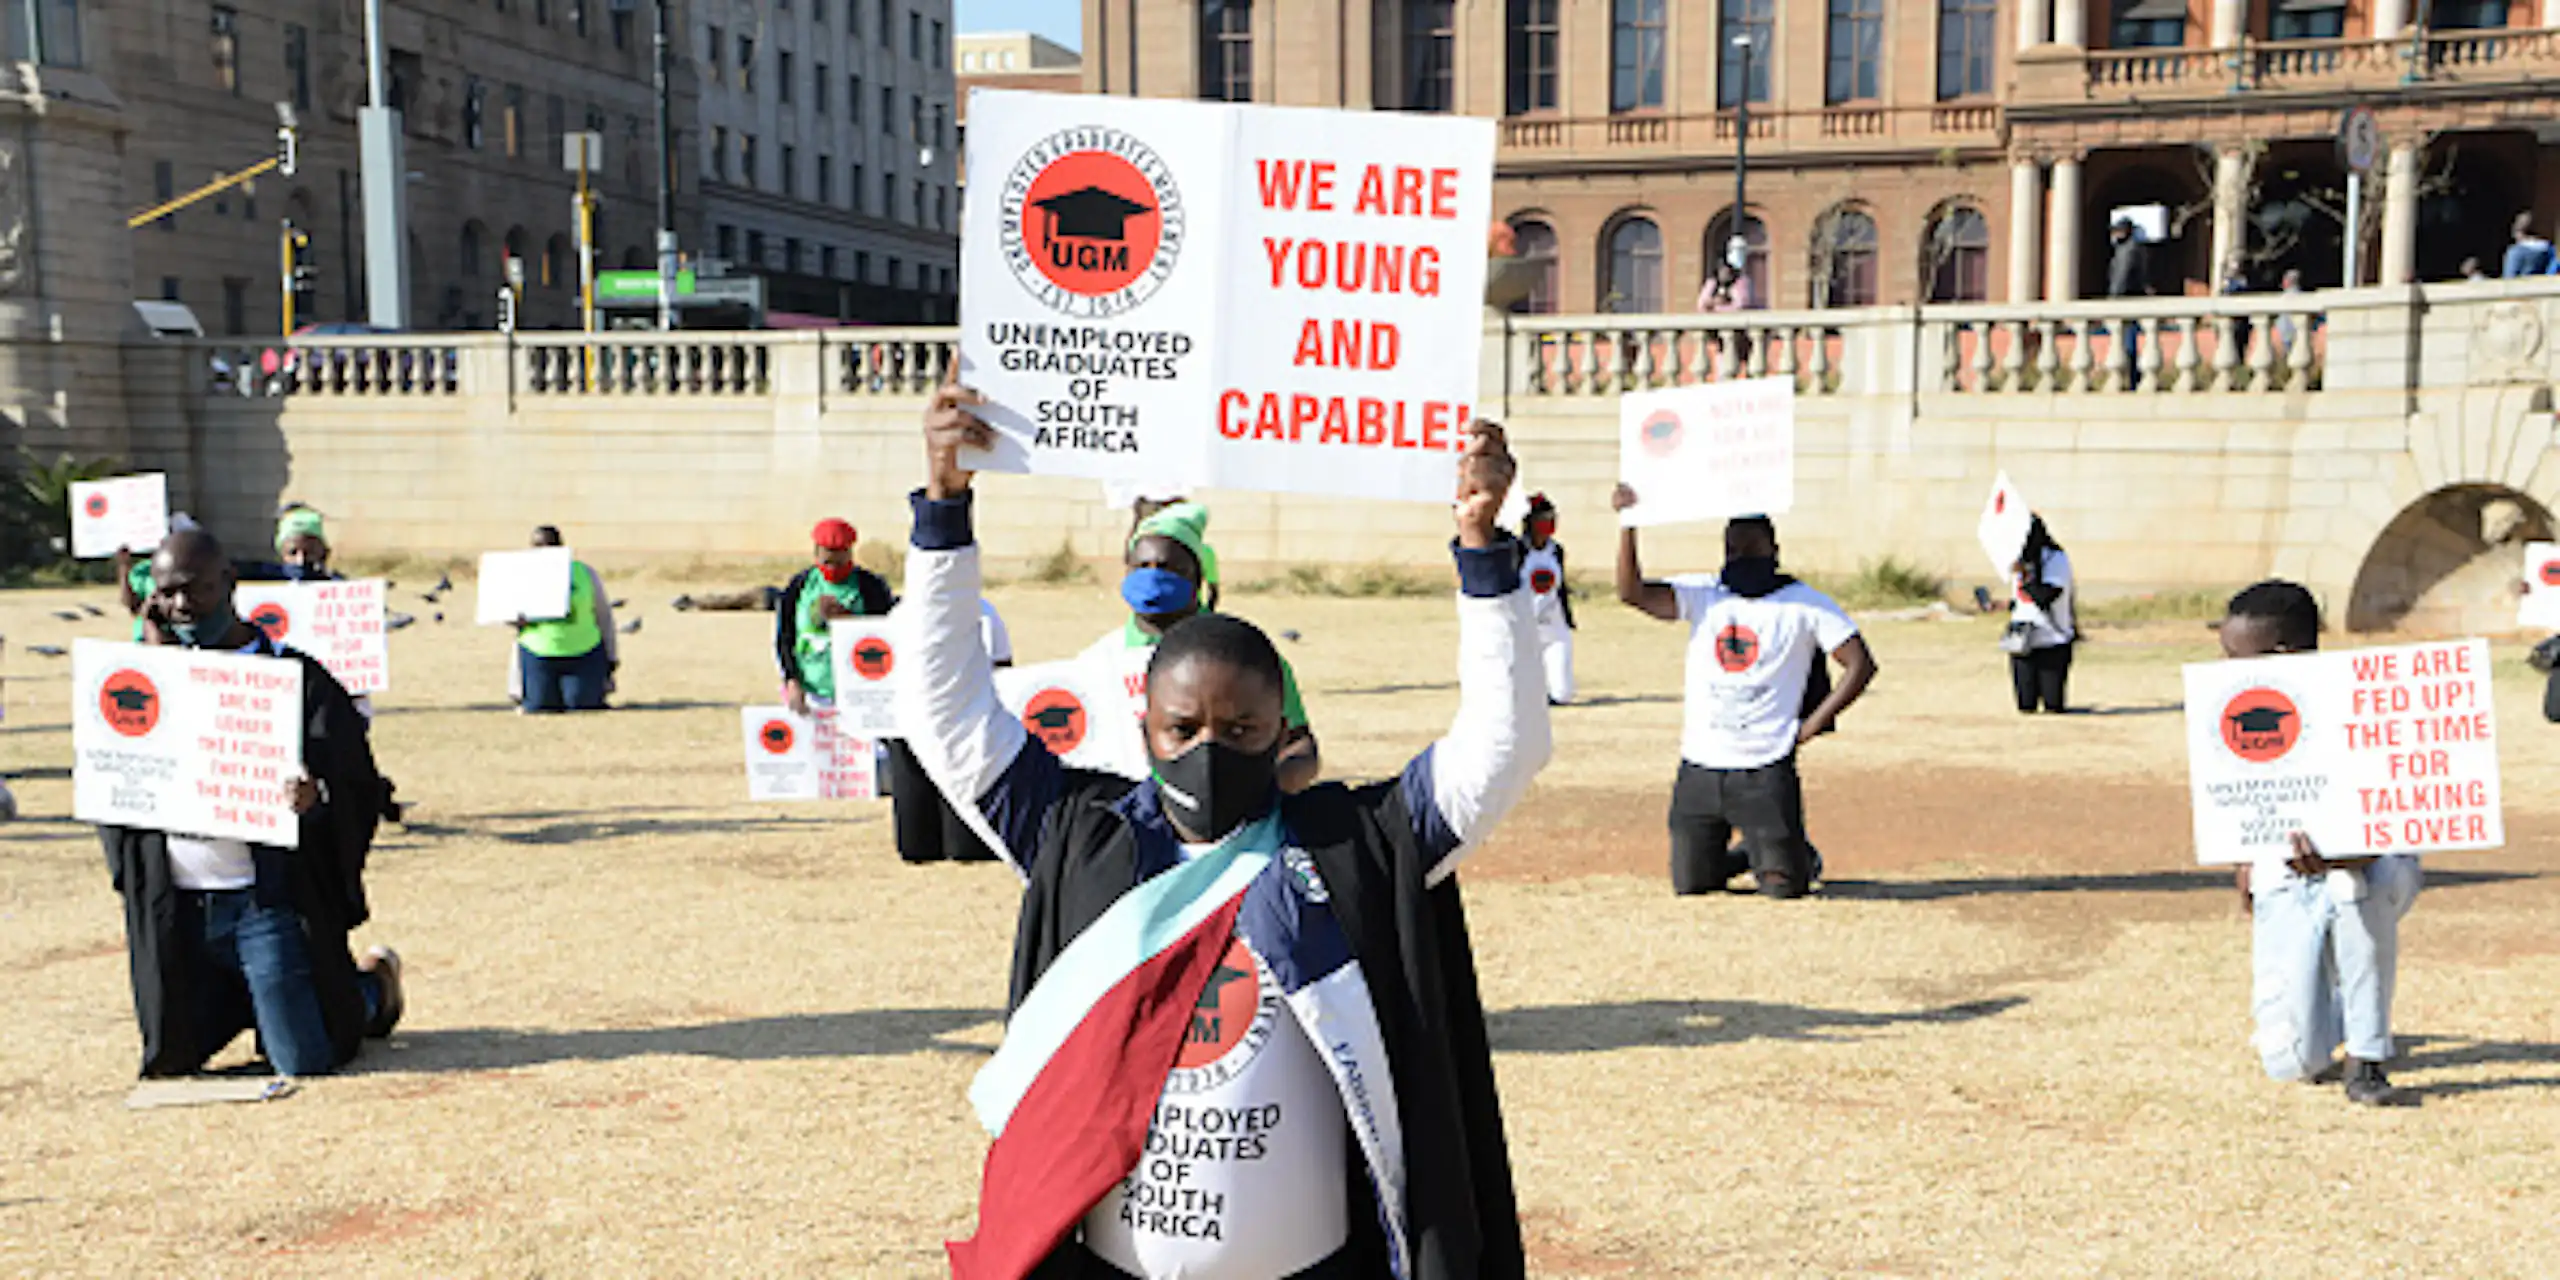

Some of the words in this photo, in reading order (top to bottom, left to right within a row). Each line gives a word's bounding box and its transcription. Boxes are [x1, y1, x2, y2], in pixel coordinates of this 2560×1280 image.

[1255, 159, 1336, 211] WE
[1353, 163, 1461, 219] ARE
[1052, 242, 1129, 272] UGM
[1263, 236, 1441, 298] YOUNG
[988, 322, 1192, 357] UNEMPLOYED
[1293, 318, 1401, 371] AND
[1000, 347, 1178, 381] GRADUATES
[1069, 377, 1108, 401] OF
[1036, 401, 1138, 427] SOUTH
[1217, 387, 1471, 453] CAPABLE!
[1034, 427, 1138, 453] AFRICA
[2353, 654, 2399, 682] WE
[2412, 646, 2471, 678] ARE
[2352, 685, 2411, 716] FED
[2421, 681, 2476, 710] UP!
[2344, 720, 2402, 750] THE
[2413, 712, 2492, 744] TIME
[2388, 749, 2449, 780] FOR
[2357, 780, 2488, 815] TALKING
[2364, 821, 2393, 848] IS
[2404, 815, 2488, 846] OVER
[1154, 1103, 1281, 1133] PLOYED
[1145, 1131, 1267, 1160] DUATES
[1151, 1159, 1190, 1184] OF
[1122, 1177, 1223, 1215] SOUTH
[1120, 1202, 1221, 1240] AFRICA
